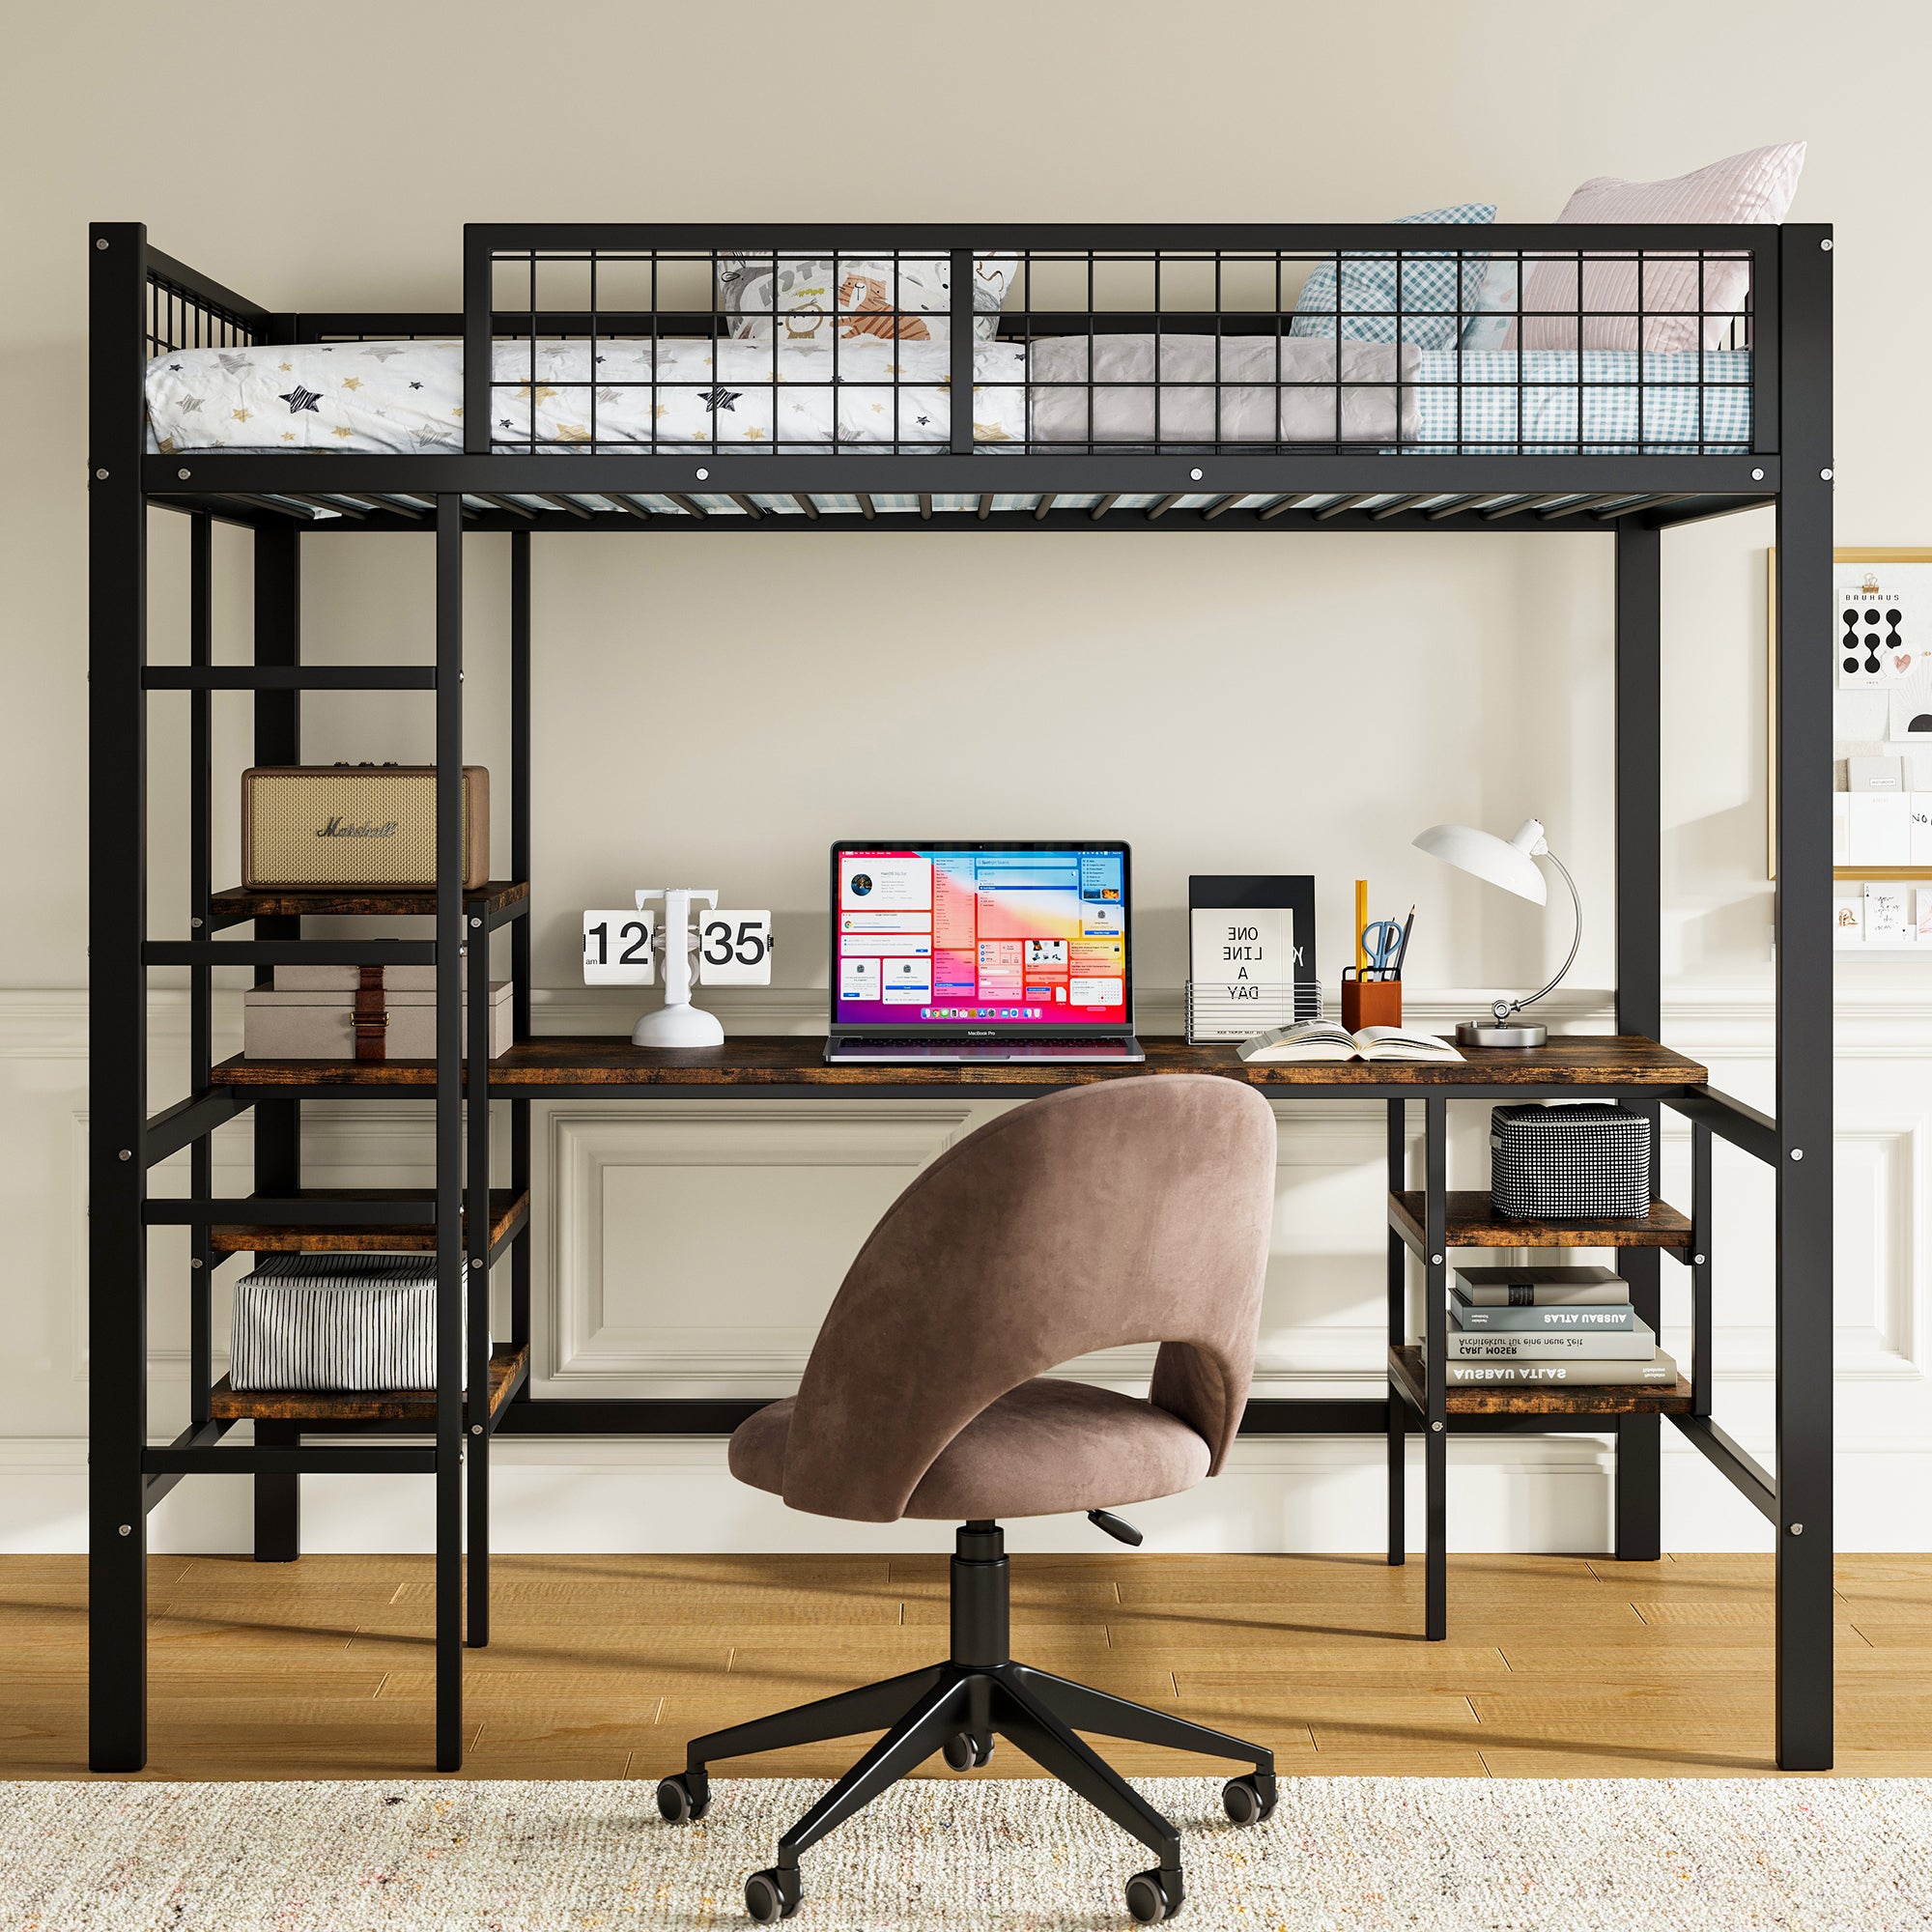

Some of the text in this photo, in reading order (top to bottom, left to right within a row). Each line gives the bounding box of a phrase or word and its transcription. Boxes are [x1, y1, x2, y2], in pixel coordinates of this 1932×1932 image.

[317, 815, 398, 838] Marshall
[588, 922, 648, 965] 12
[703, 922, 765, 965] 35
[1544, 1314, 1627, 1323] AUSBAU ATLAS
